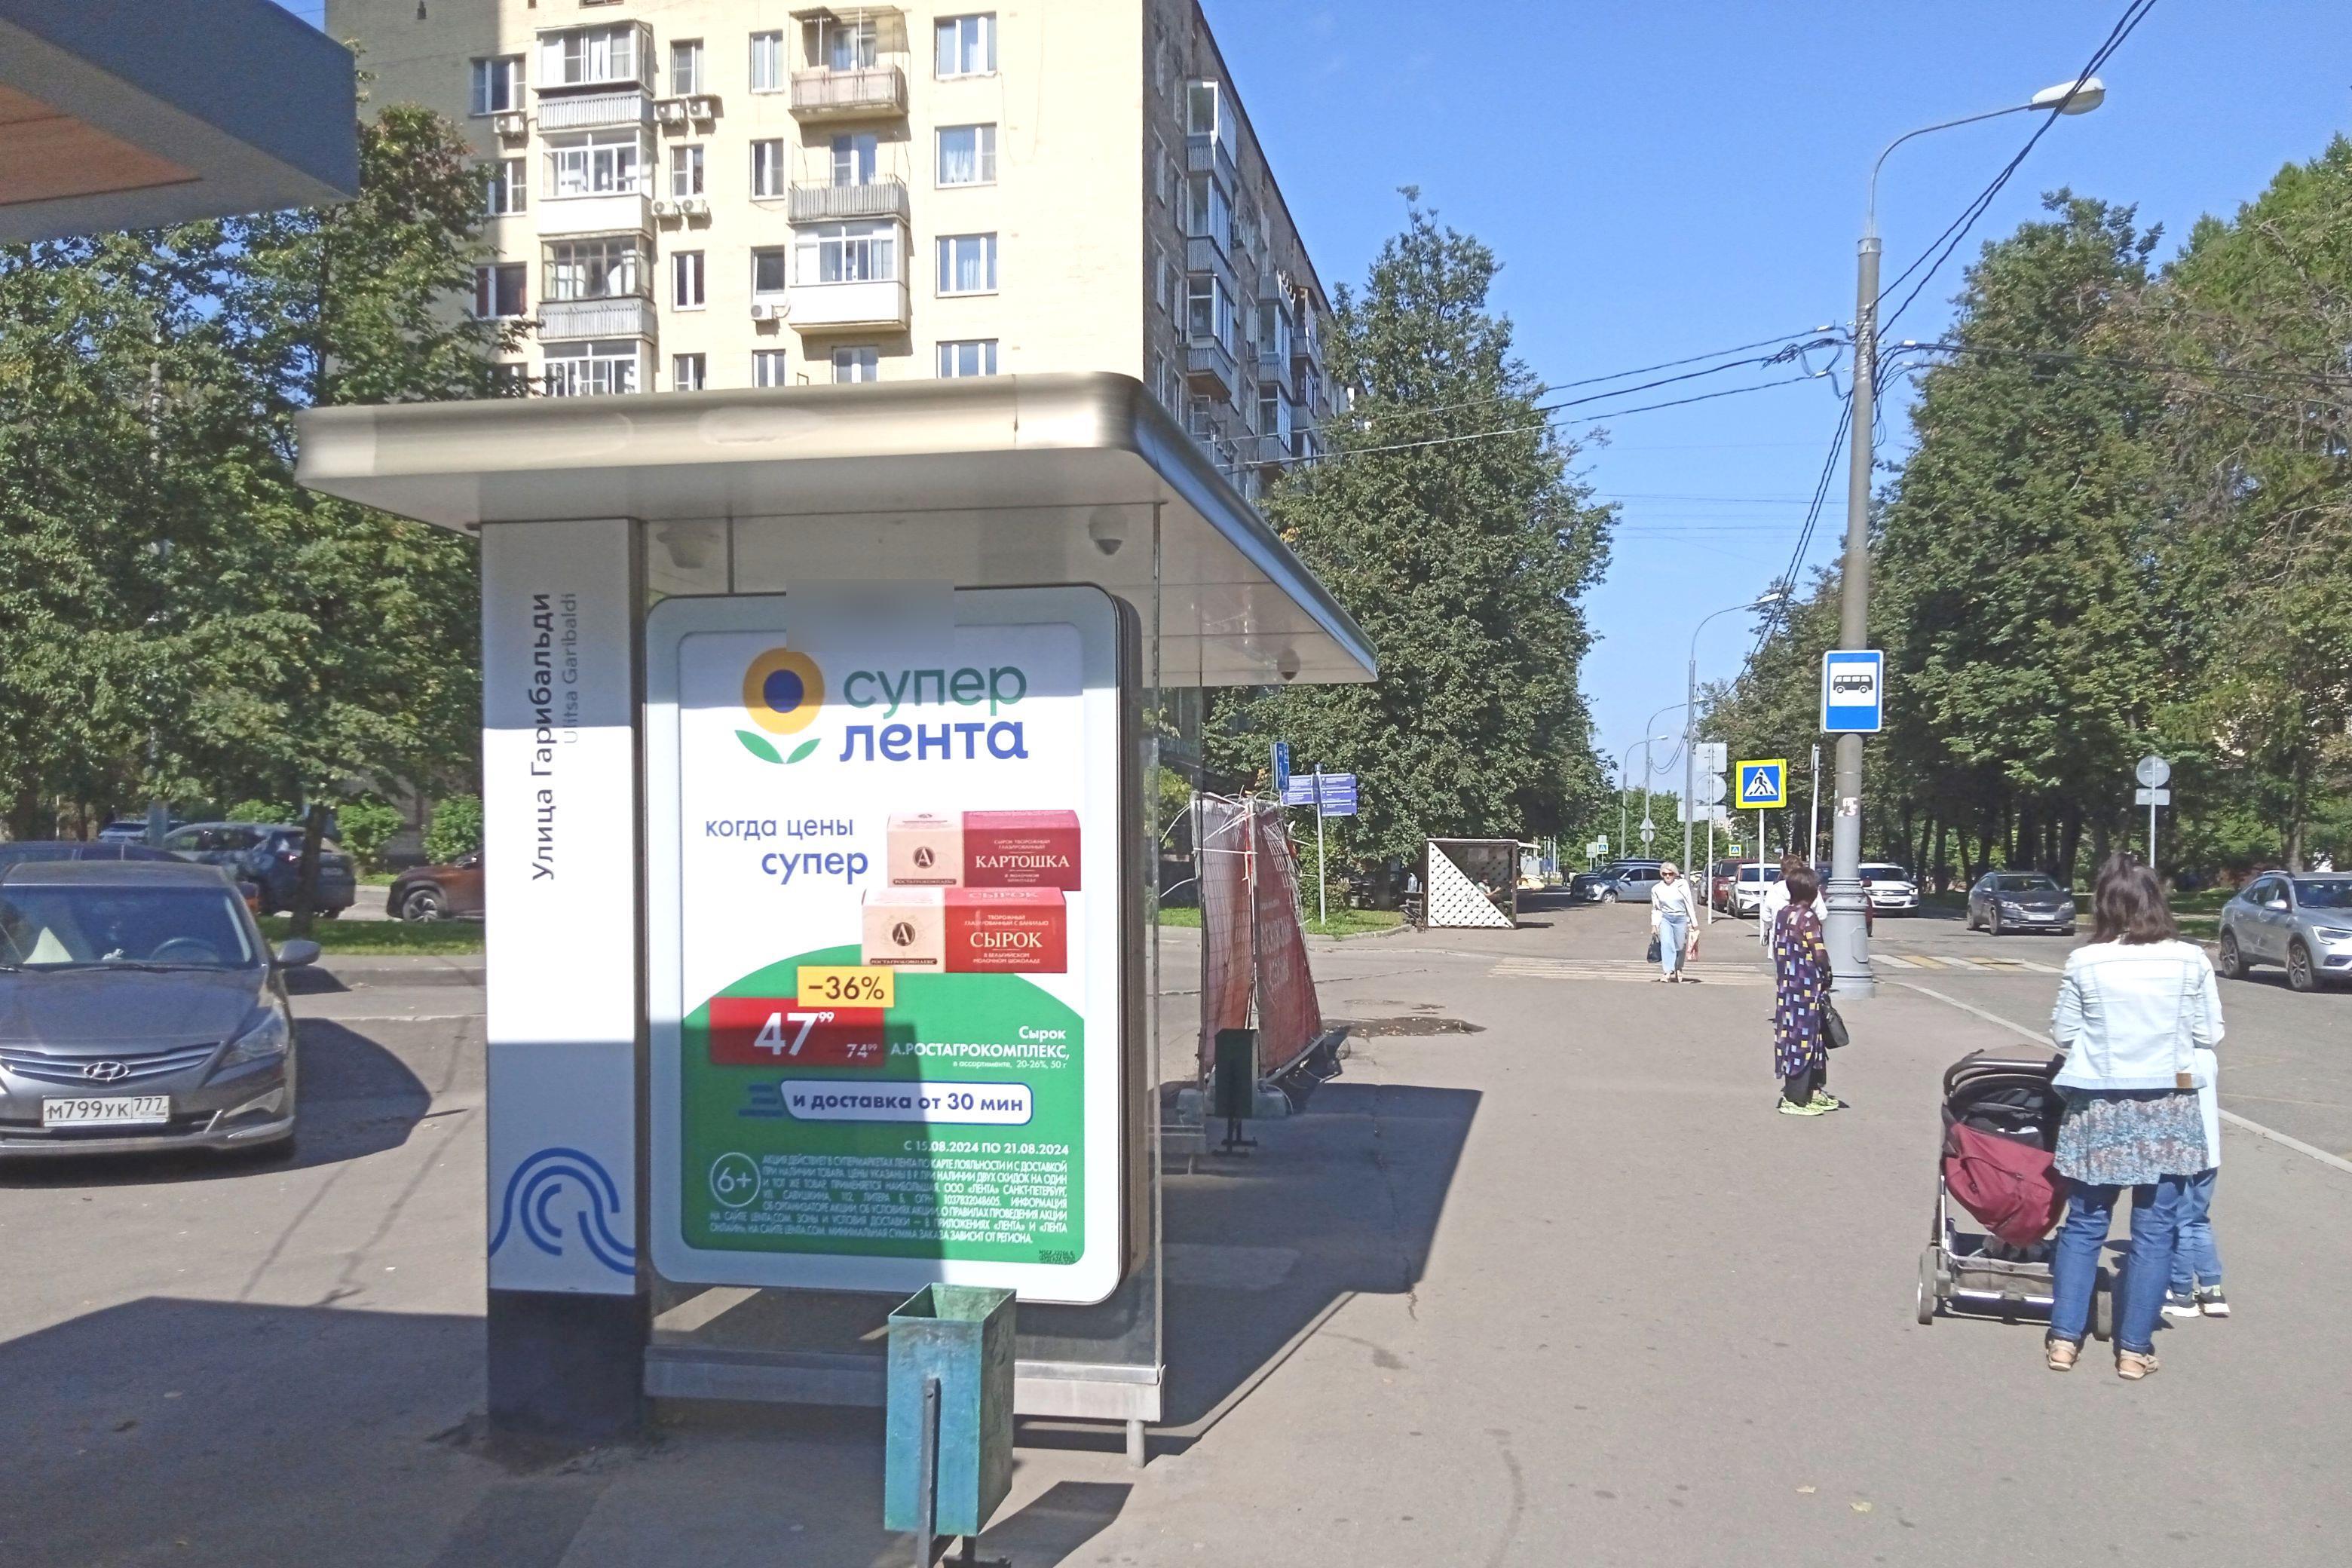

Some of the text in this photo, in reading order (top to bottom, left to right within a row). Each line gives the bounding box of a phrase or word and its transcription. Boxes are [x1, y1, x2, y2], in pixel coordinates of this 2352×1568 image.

[561, 592, 578, 744] Ulitsa Garibaldi
[843, 666, 1028, 721] супер
[528, 593, 557, 881] Улица Гарибальди
[839, 720, 1029, 761] лента
[706, 816, 853, 840] когда цены
[761, 848, 868, 885] супер
[975, 855, 1070, 868] КАРТОШКА
[969, 932, 1043, 948] СЫРОК
[1018, 1026, 1067, 1040] Сырок
[891, 1043, 1070, 1060] А.РОСТАГРОКОМПЛЕКС,
[958, 1061, 1012, 1069] ассортименте,
[1015, 1060, 1049, 1069] 20-26%,
[133, 1097, 163, 1111] 777
[793, 1093, 1024, 1111] и доставка от 30 мин
[903, 1141, 1069, 1155] С 15.08.2024 ПО 21.08.2024
[930, 1158, 954, 1168] КАРТЕ
[954, 1159, 1006, 1170] ЛОЯЛЬНОСТИ
[1006, 1160, 1012, 1170] И
[1014, 1161, 1020, 1171] С
[1020, 1159, 1067, 1173] ДОСТАВКОЙ
[716, 1167, 752, 1193] 6+
[976, 1171, 996, 1182] ДВУХ
[997, 1172, 1030, 1184] СКИДОК
[1031, 1174, 1043, 1184] НА
[1043, 1174, 1067, 1185] ОДИН
[944, 1183, 964, 1193] ООО
[968, 1184, 1000, 1193] «ЛЕНТА»
[1003, 1184, 1067, 1197] САНКТ-ПЕТЕРБУРГ,
[1011, 1196, 1067, 1209] ИНФОРМАЦИЯ
[941, 1206, 948, 1217] О
[949, 1207, 988, 1217] ПРАВИЛАХ
[989, 1208, 1038, 1220] ПРОВЕДЕНИЯ
[1039, 1209, 1067, 1221] АКЦИИ
[994, 1220, 1025, 1230] «ЛЕНТА»
[1029, 1221, 1036, 1231] И
[1039, 1222, 1067, 1233] «ЛЕНТА
[950, 1230, 985, 1242] ЗАВИСИТ
[985, 1232, 995, 1242] ОТ
[997, 1232, 1034, 1243] РЕГИОНА.
